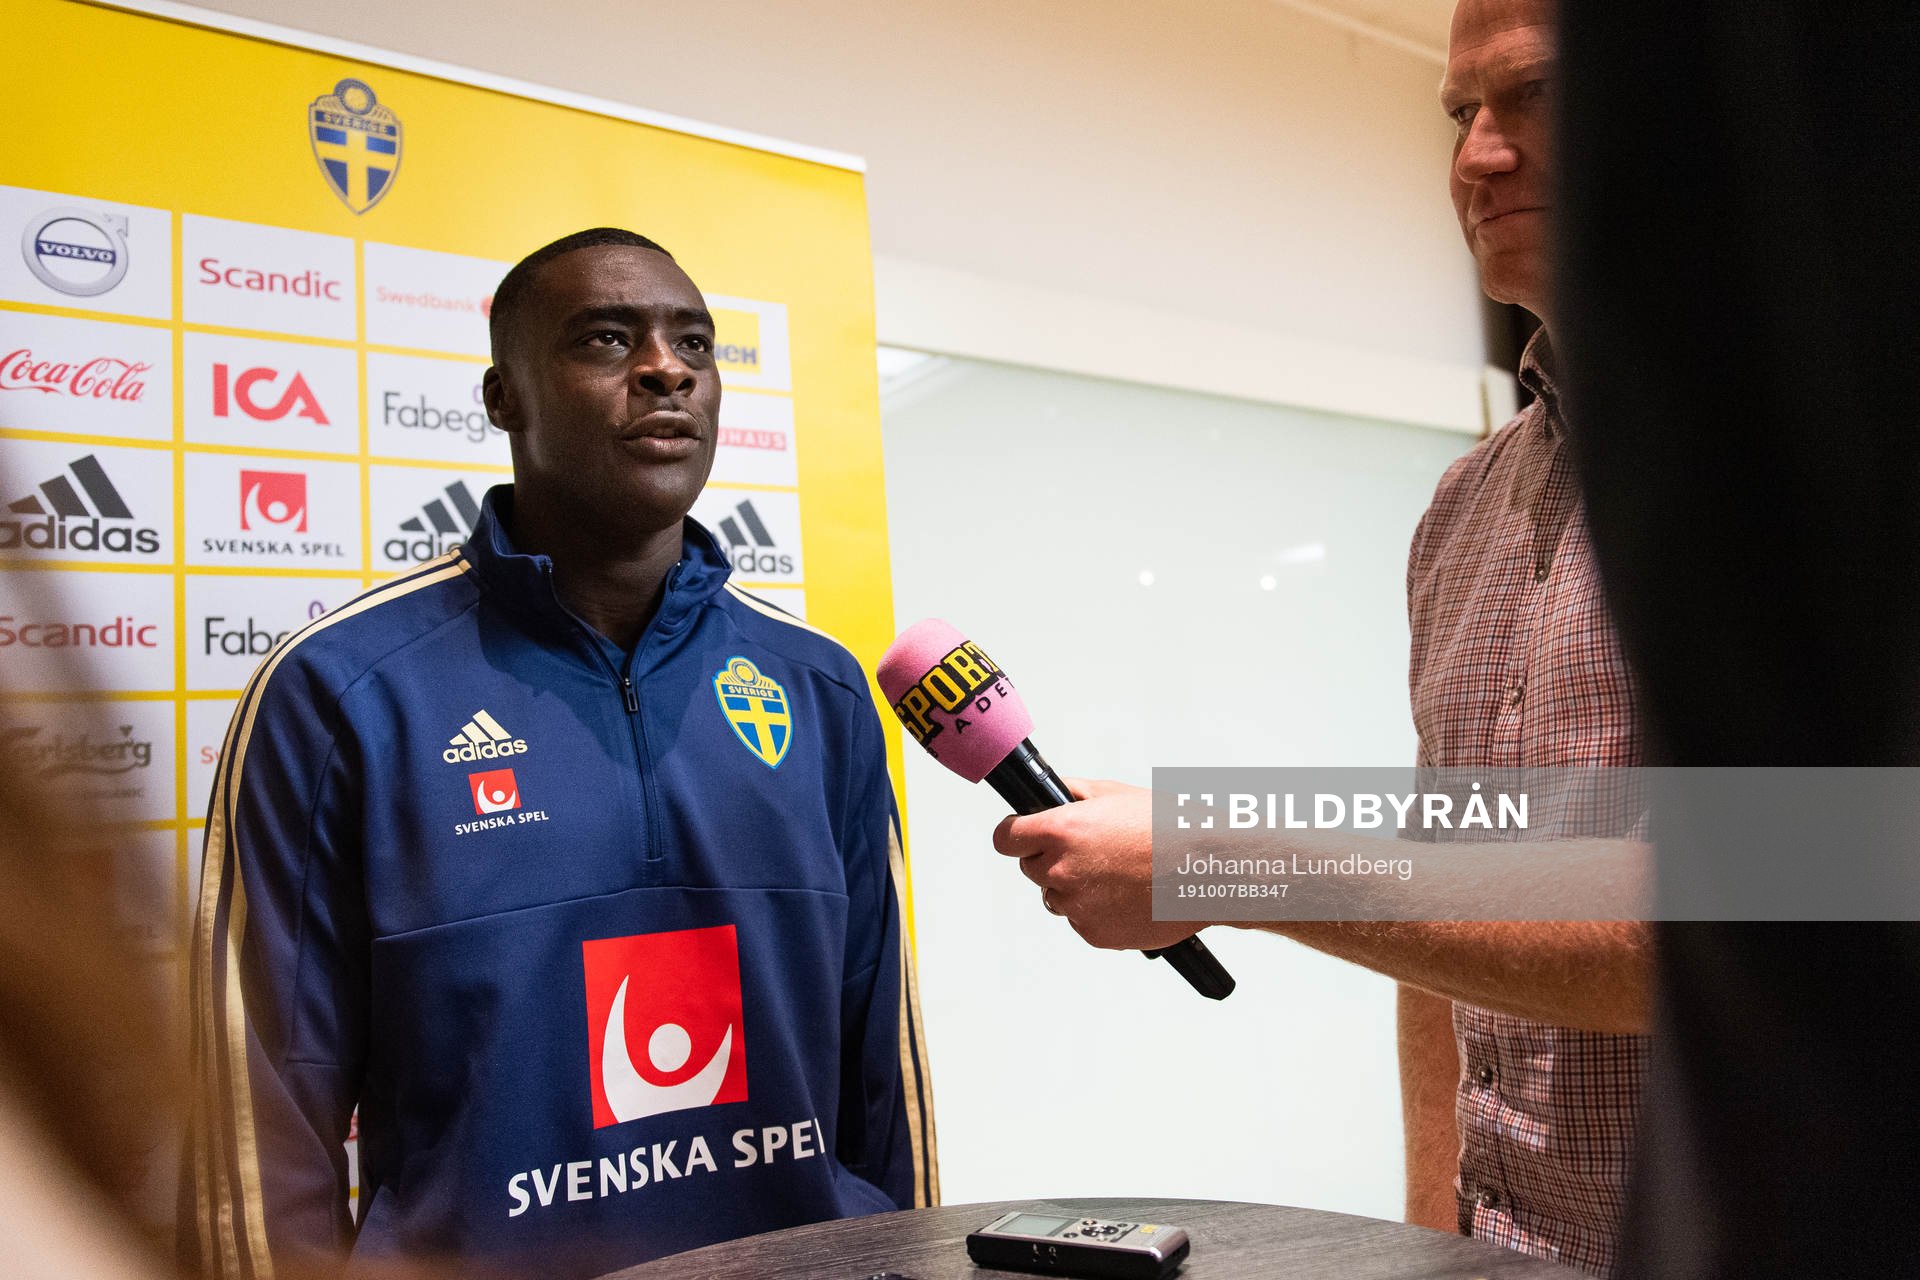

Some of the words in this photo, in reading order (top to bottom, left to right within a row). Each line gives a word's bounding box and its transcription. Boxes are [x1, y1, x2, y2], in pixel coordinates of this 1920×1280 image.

[39, 241, 114, 263] VOLVO
[199, 257, 342, 301] Scandic
[377, 286, 475, 313] Swedbank
[0, 348, 153, 402] Coca-Cola
[212, 362, 331, 425] ICA
[0, 515, 160, 554] adidas
[203, 538, 293, 555] SVENSKA
[301, 542, 345, 557] SPEL
[725, 547, 794, 574] idas
[0, 616, 158, 648] Scandic
[728, 685, 775, 698] SVERIGE
[443, 739, 529, 764] adidas
[454, 815, 516, 836] SVENSKA
[518, 810, 550, 824] SPEL
[508, 1135, 718, 1218] SVENSKA
